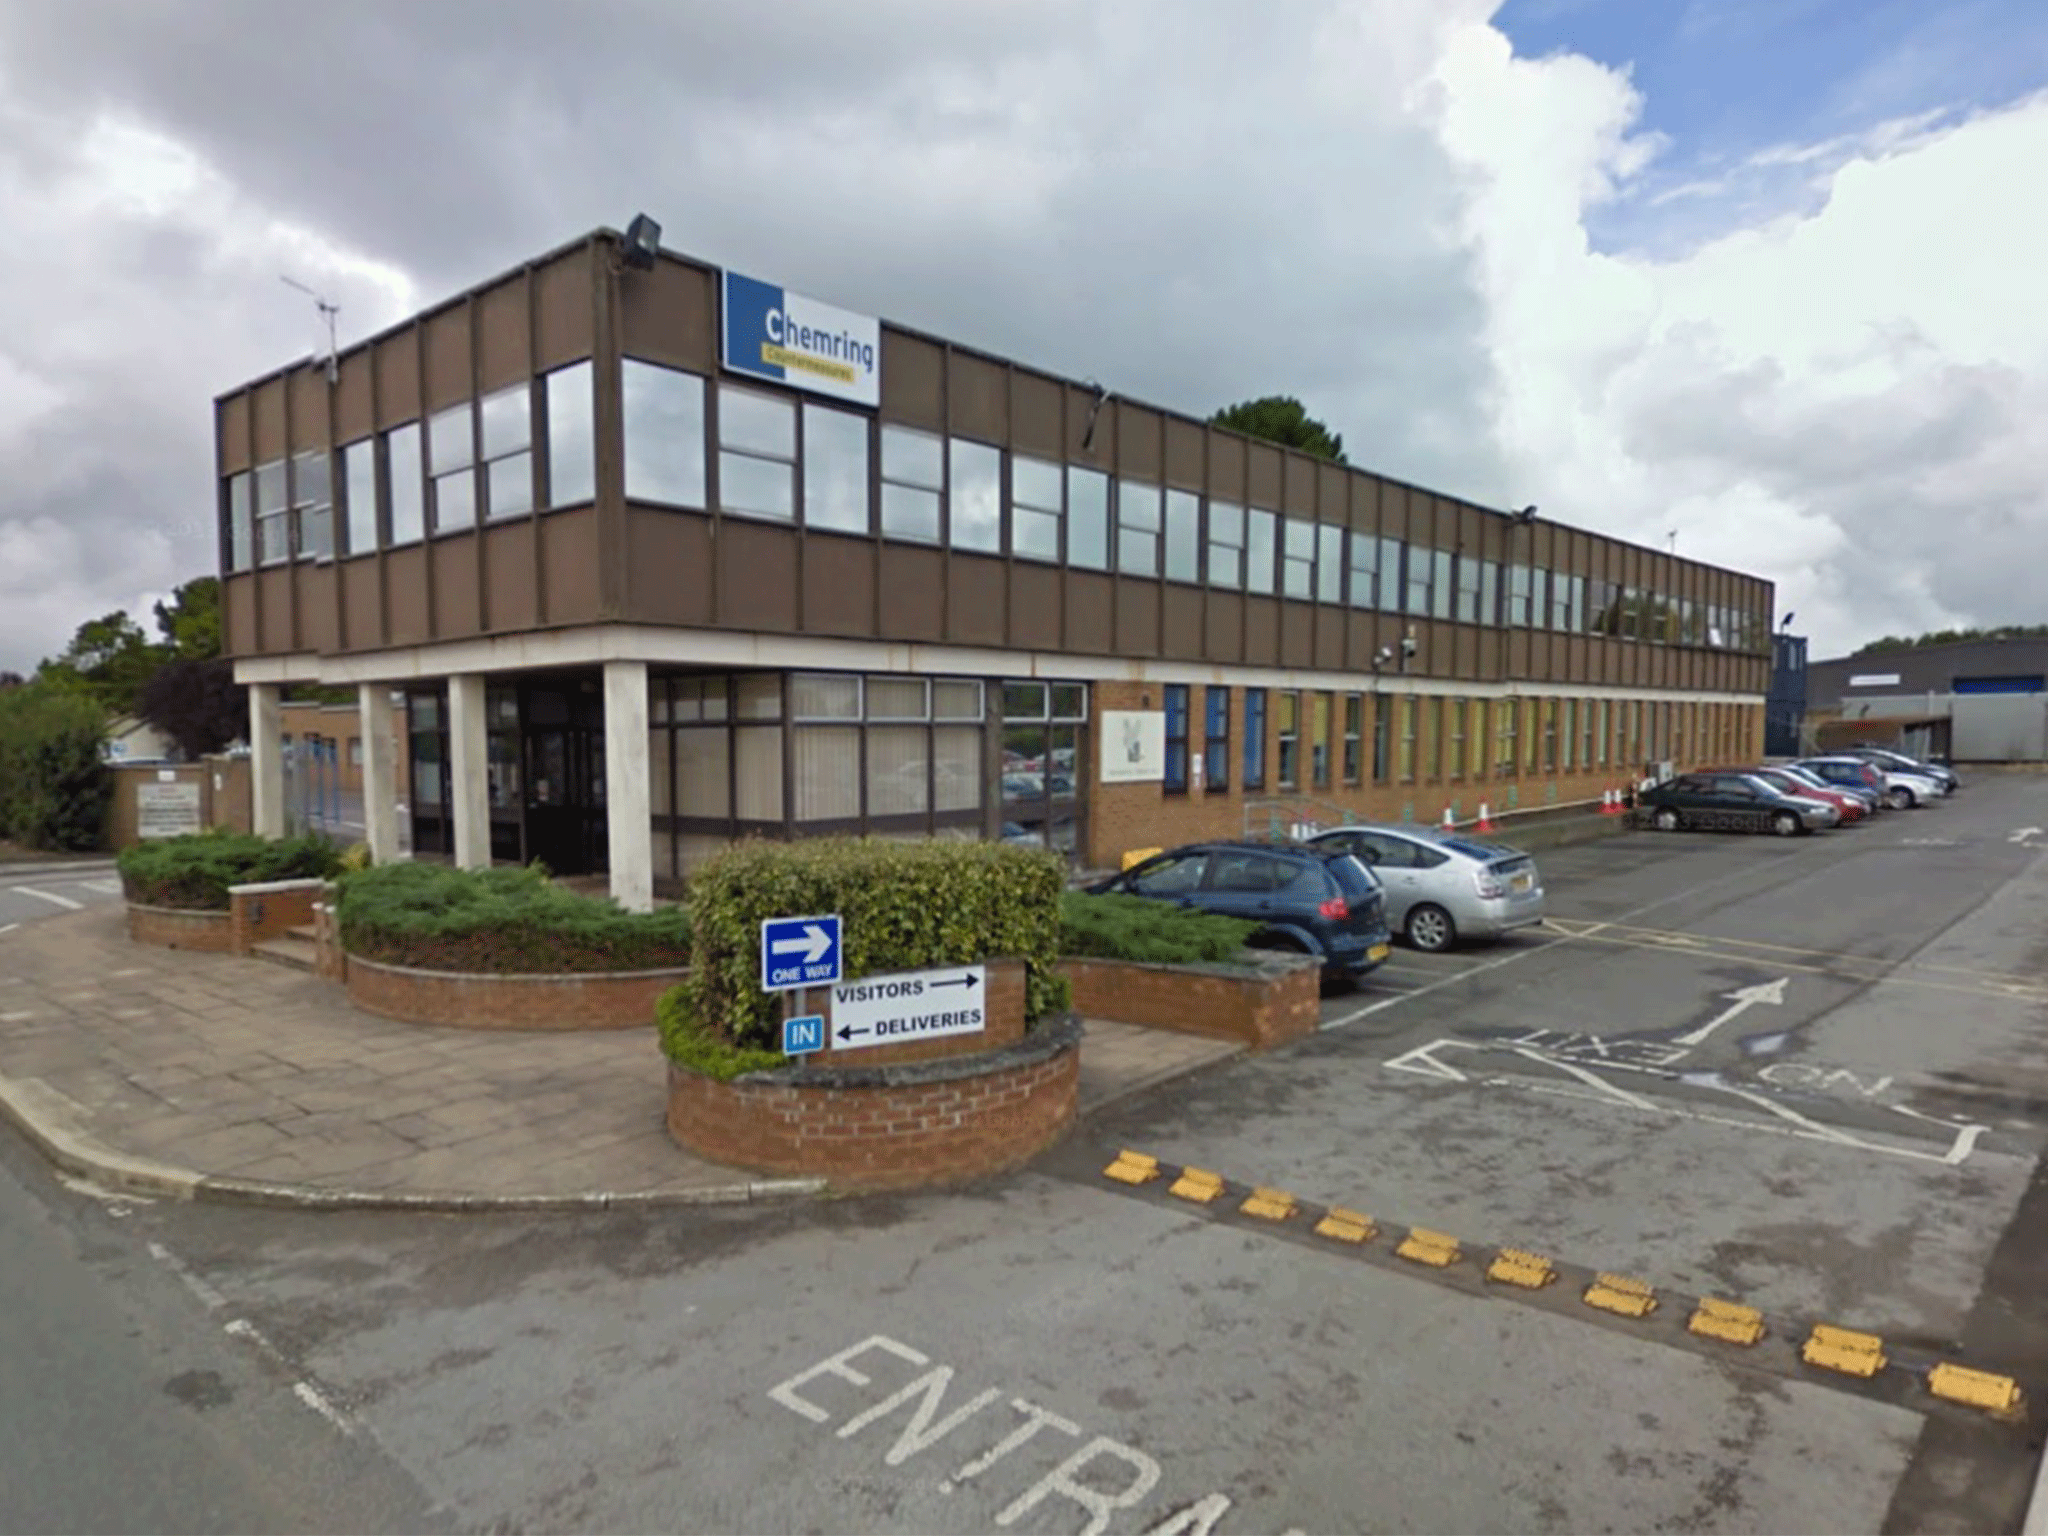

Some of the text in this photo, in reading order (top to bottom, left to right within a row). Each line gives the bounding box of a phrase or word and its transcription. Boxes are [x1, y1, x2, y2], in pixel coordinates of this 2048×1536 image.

[766, 308, 873, 374] Chemring
[771, 963, 833, 983] ONE WAY
[836, 980, 923, 1003] VISITORS
[875, 1008, 982, 1036] DELIVERIES
[792, 1023, 816, 1046] IN
